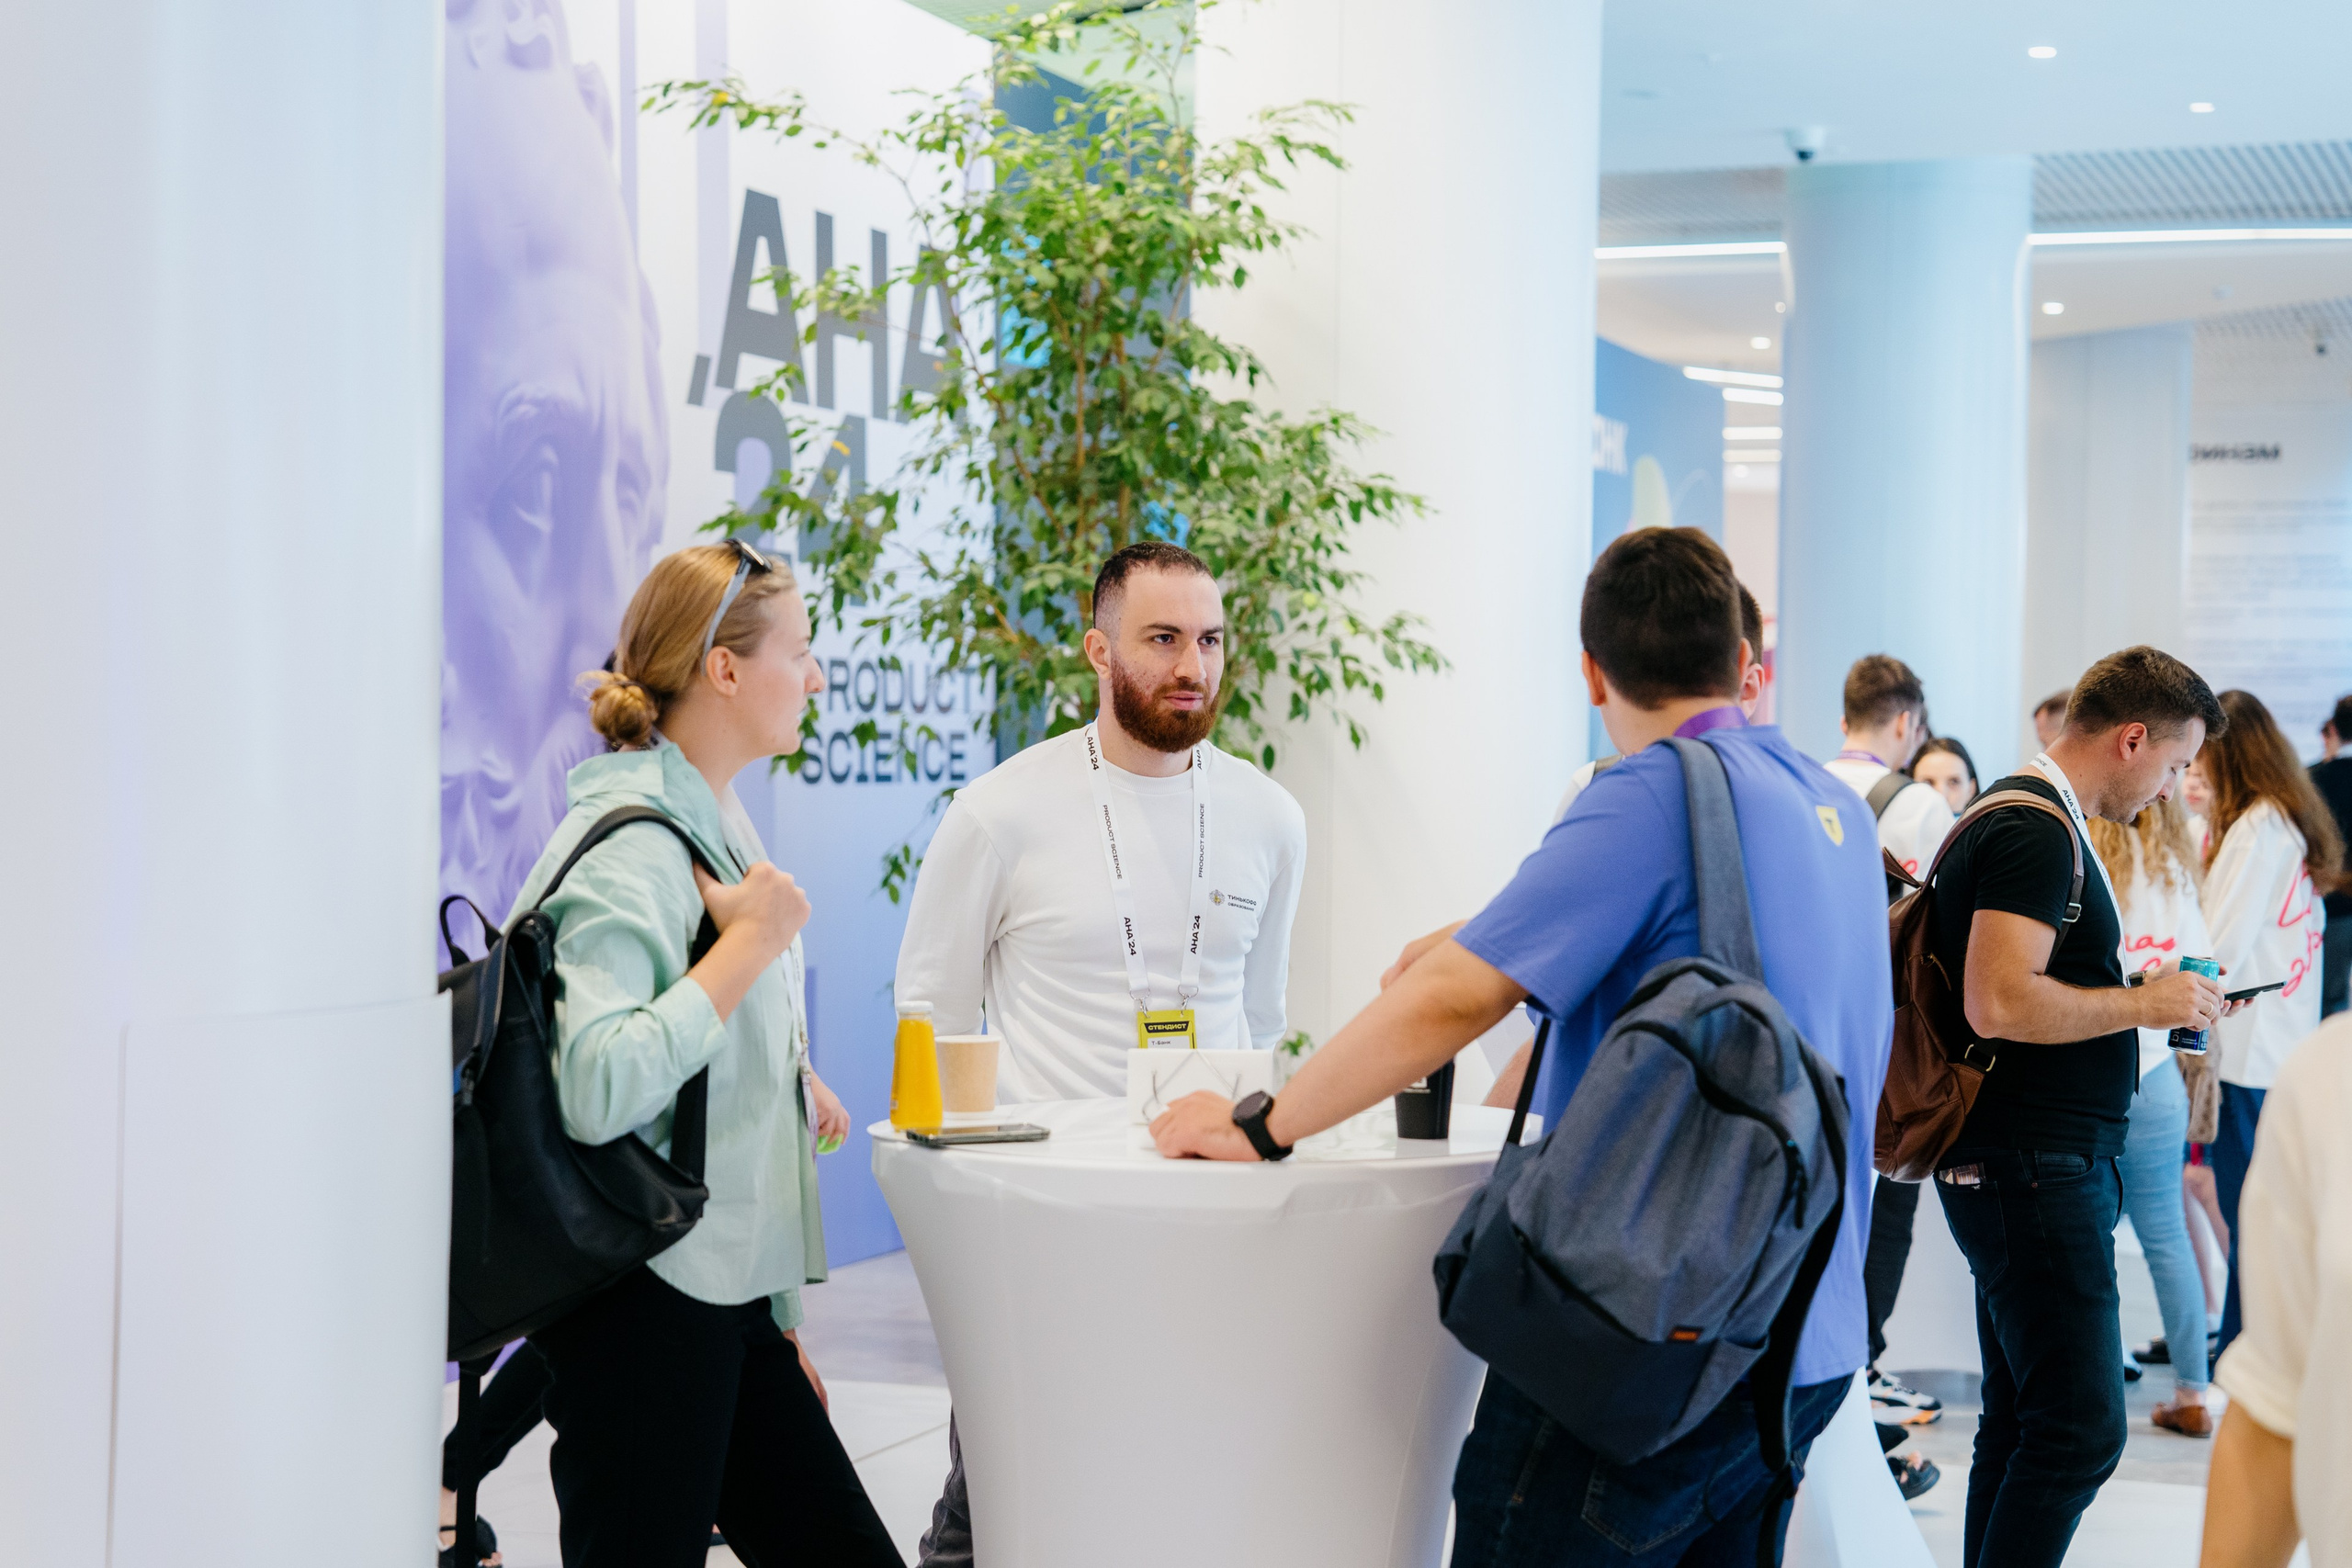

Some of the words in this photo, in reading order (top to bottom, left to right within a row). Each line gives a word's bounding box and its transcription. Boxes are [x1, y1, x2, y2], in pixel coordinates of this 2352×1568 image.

[817, 658, 978, 713] RODUCT
[800, 731, 965, 784] SCIENCE
[1102, 805, 1115, 842] PRODUCT
[1110, 842, 1123, 880] SCIENCE
[1124, 917, 1136, 955] AHA'24
[1190, 915, 1201, 954] AHA'24
